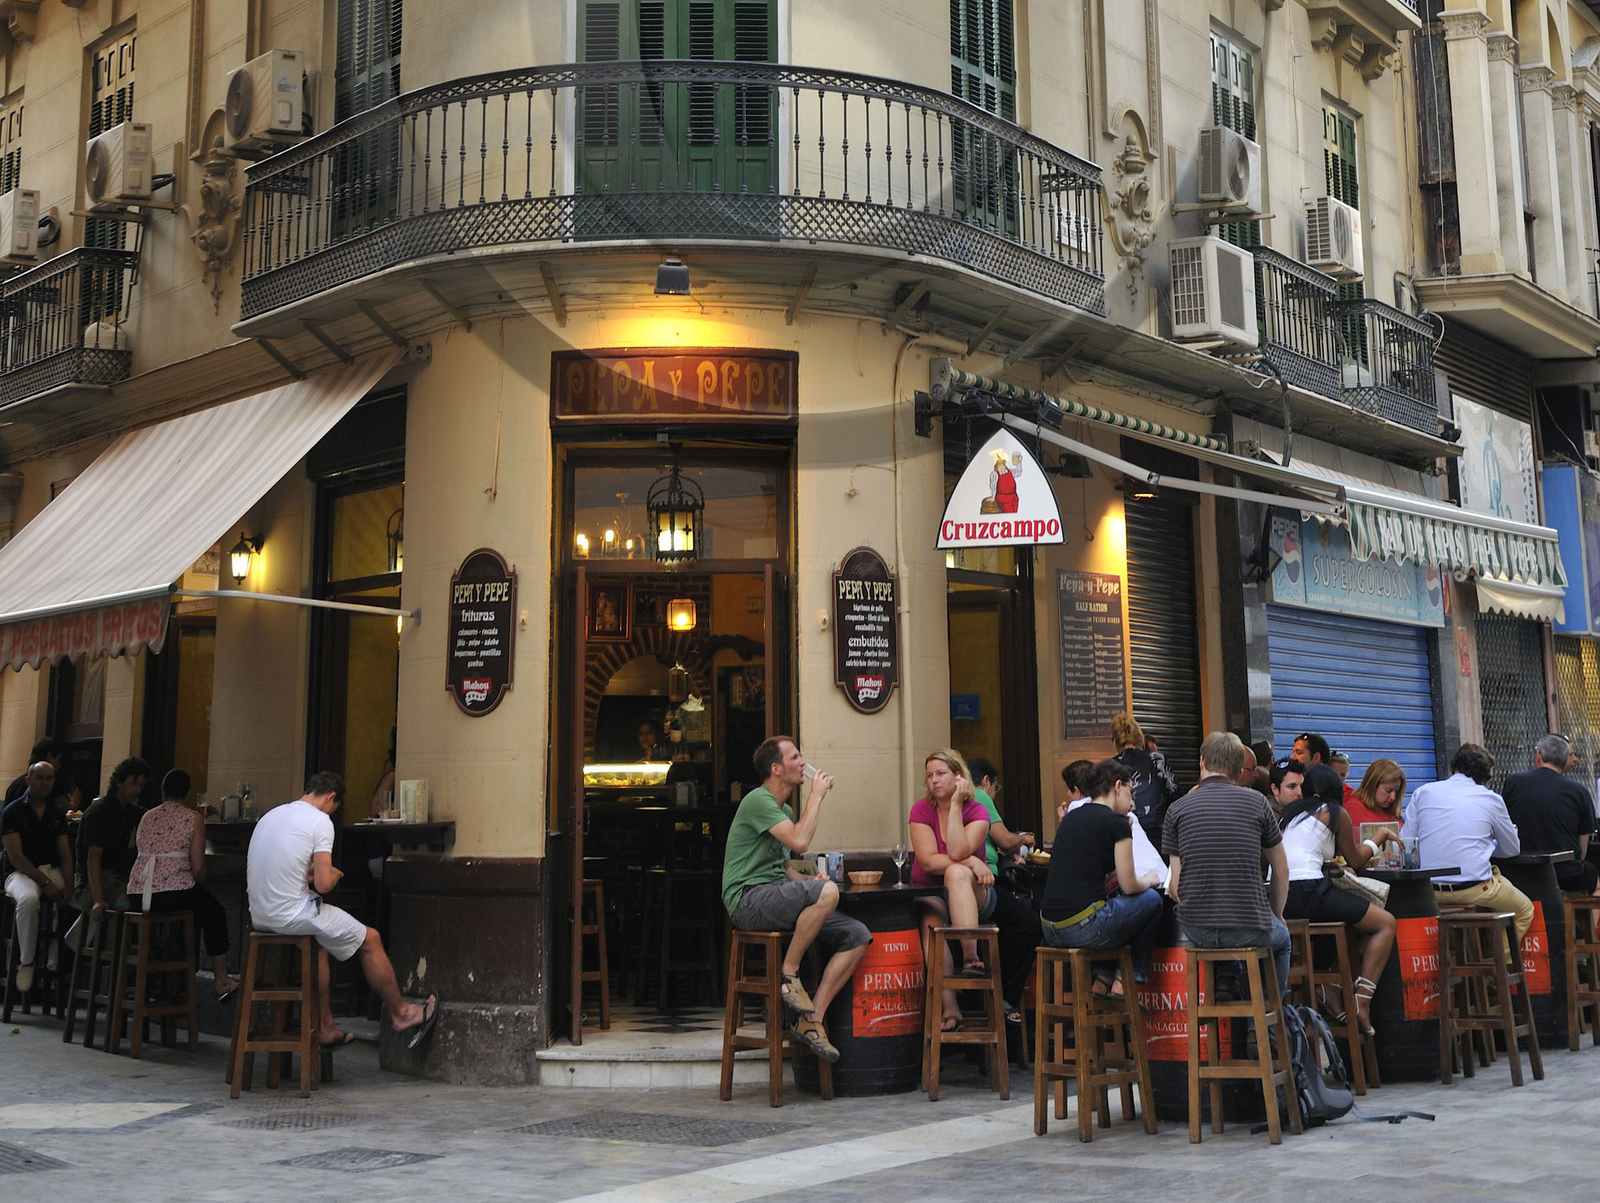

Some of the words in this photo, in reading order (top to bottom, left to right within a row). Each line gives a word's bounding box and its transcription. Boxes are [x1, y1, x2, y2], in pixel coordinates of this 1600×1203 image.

[565, 360, 659, 413] PEPA
[696, 360, 786, 412] PEPE
[942, 519, 1060, 542] Cruzcampo
[1271, 516, 1299, 541] PEPSI
[1377, 514, 1405, 554] BAR
[1407, 520, 1425, 557] DE
[1426, 524, 1464, 563] TAPAS
[1469, 532, 1500, 567] PEPA
[1510, 540, 1539, 572] PEPE
[453, 584, 474, 604] PEPA
[475, 583, 482, 603] Y
[483, 582, 509, 602] PEPE
[839, 580, 864, 600] PEPA
[864, 581, 871, 600] Y
[873, 582, 893, 602] PEPE
[1060, 574, 1084, 593] Pepa
[1087, 580, 1093, 595] y
[1096, 577, 1120, 597] Pepe
[461, 609, 495, 622] frituras
[1075, 601, 1088, 611] HALF
[1089, 602, 1108, 613] RATION
[11, 614, 94, 658] PESCAITOS
[100, 601, 161, 647] FRITOS
[848, 635, 889, 647] embutidos
[463, 680, 489, 691] Mahou
[857, 677, 882, 687] Mahou
[883, 942, 909, 952] TINTO
[1153, 962, 1184, 972] TINTO
